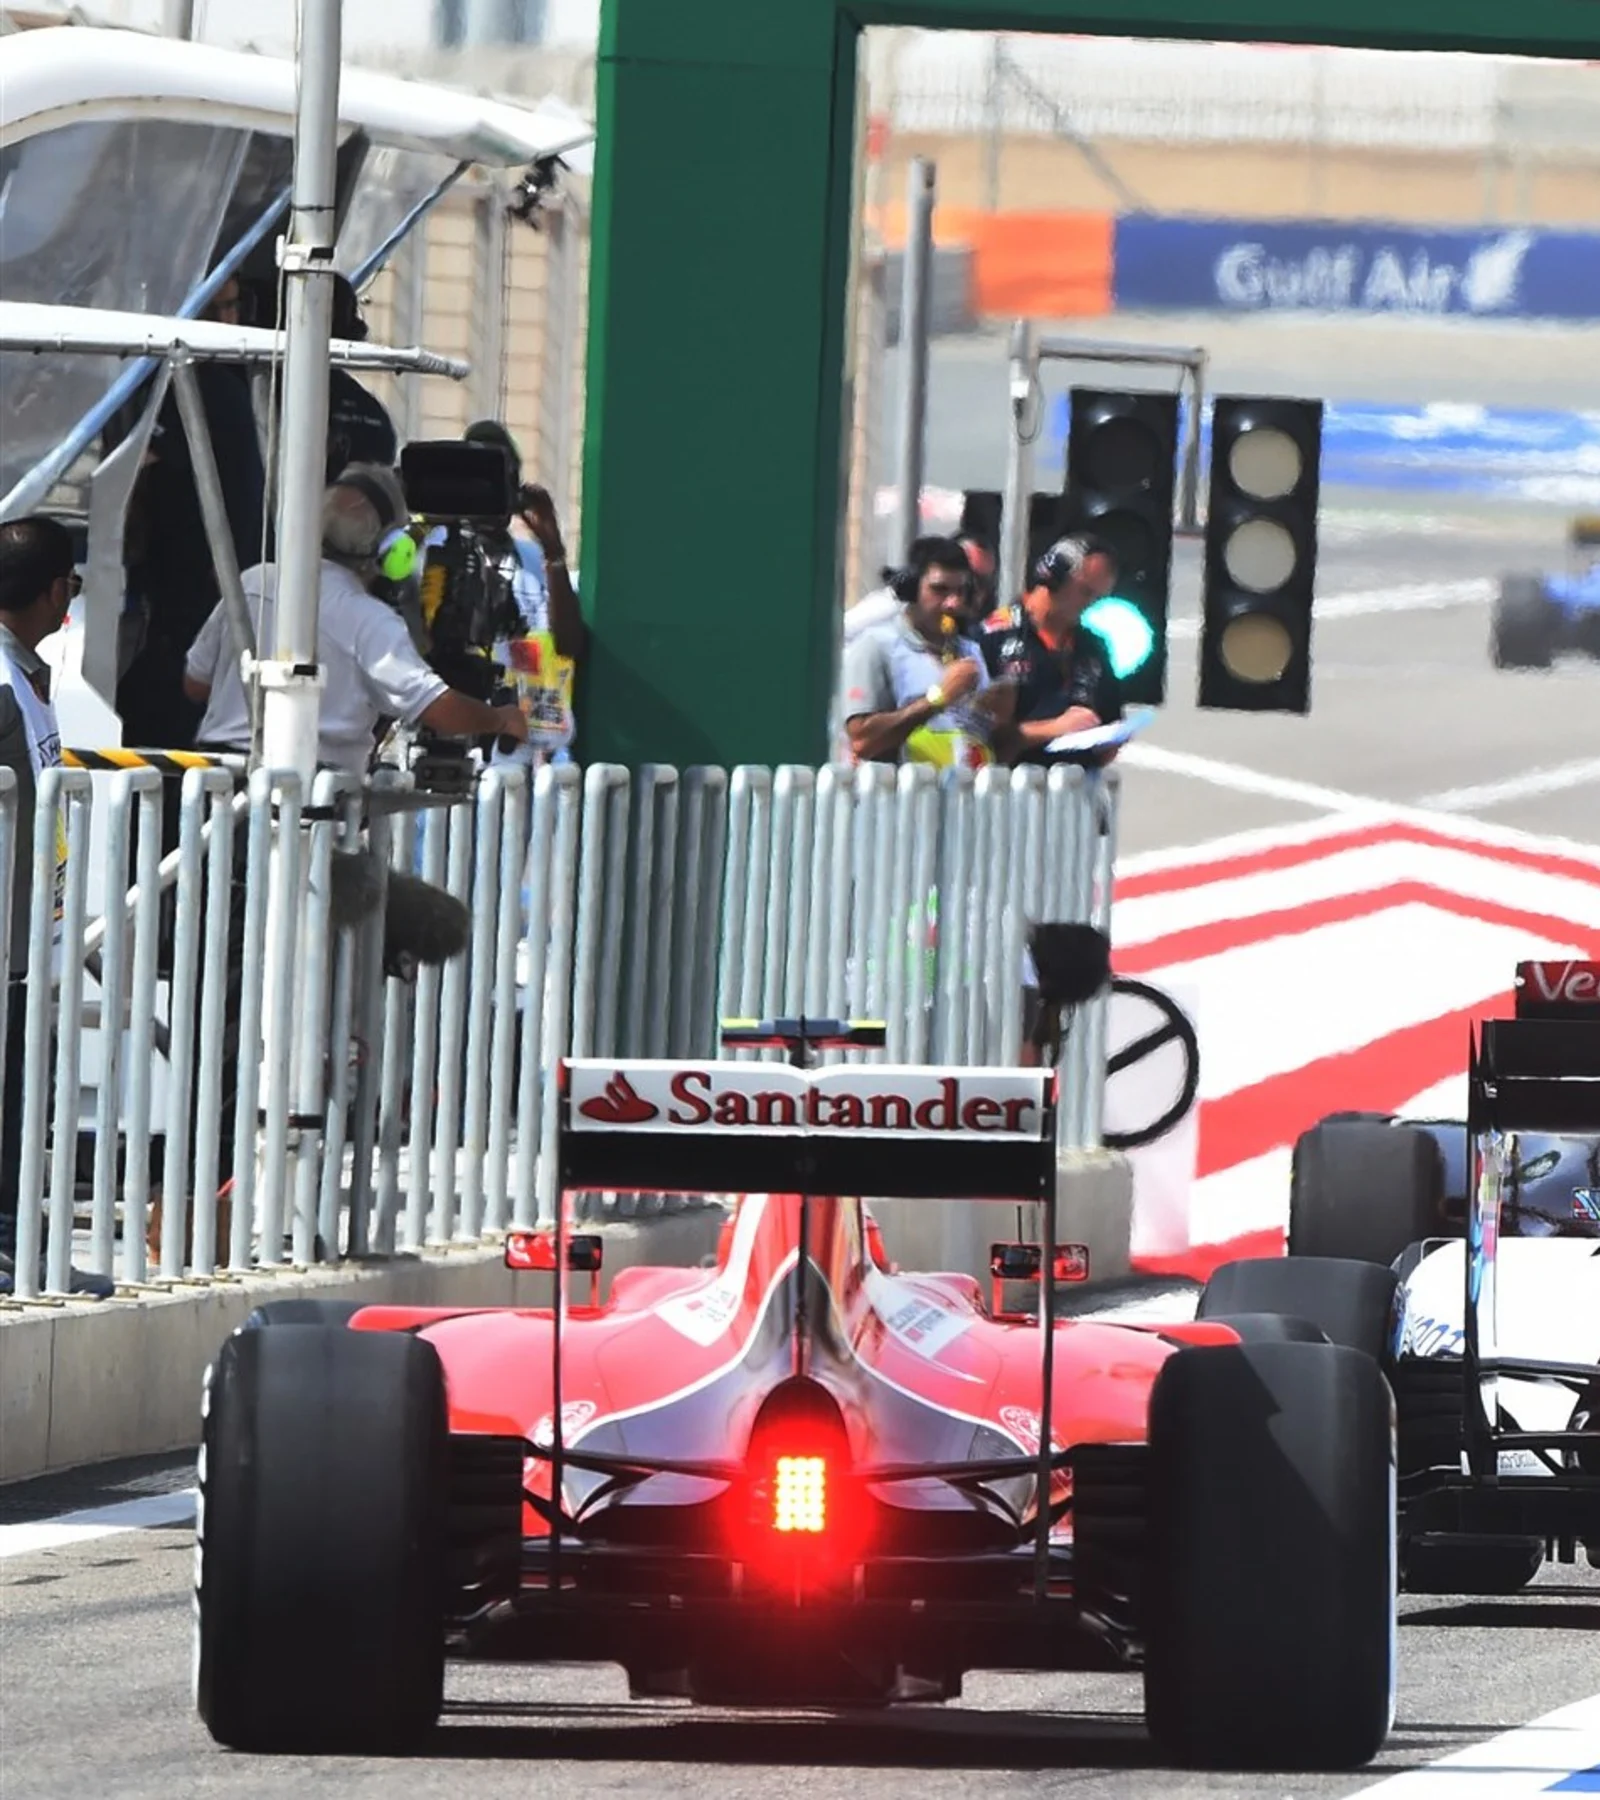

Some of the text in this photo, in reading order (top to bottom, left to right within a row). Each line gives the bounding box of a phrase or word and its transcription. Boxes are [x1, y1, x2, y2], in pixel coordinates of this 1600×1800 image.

[1215, 243, 1457, 312] Gulf Air
[667, 1071, 1035, 1132] Santander
